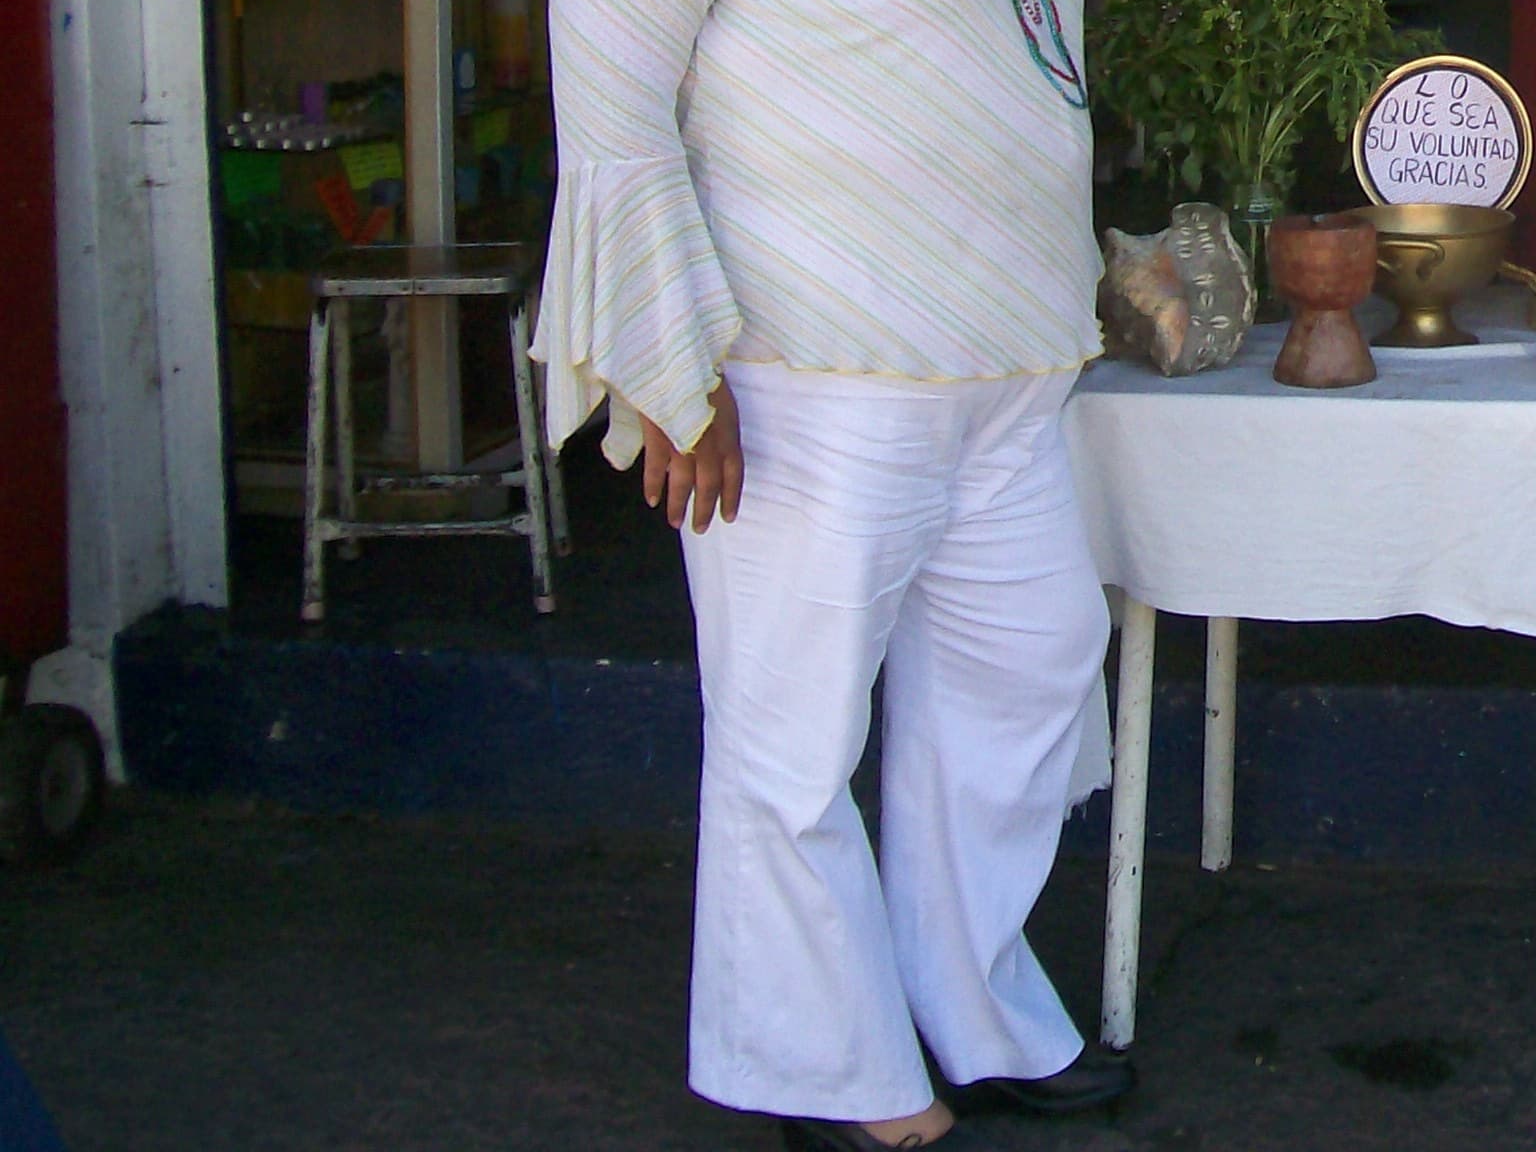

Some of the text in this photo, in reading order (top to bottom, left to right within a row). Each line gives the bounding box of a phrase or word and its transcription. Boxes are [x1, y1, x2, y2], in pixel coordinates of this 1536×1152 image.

[1380, 98, 1500, 131] QUE SEA
[1366, 126, 1516, 161] SU VOLUNTAD.
[1388, 156, 1488, 190] GRACIAS.
